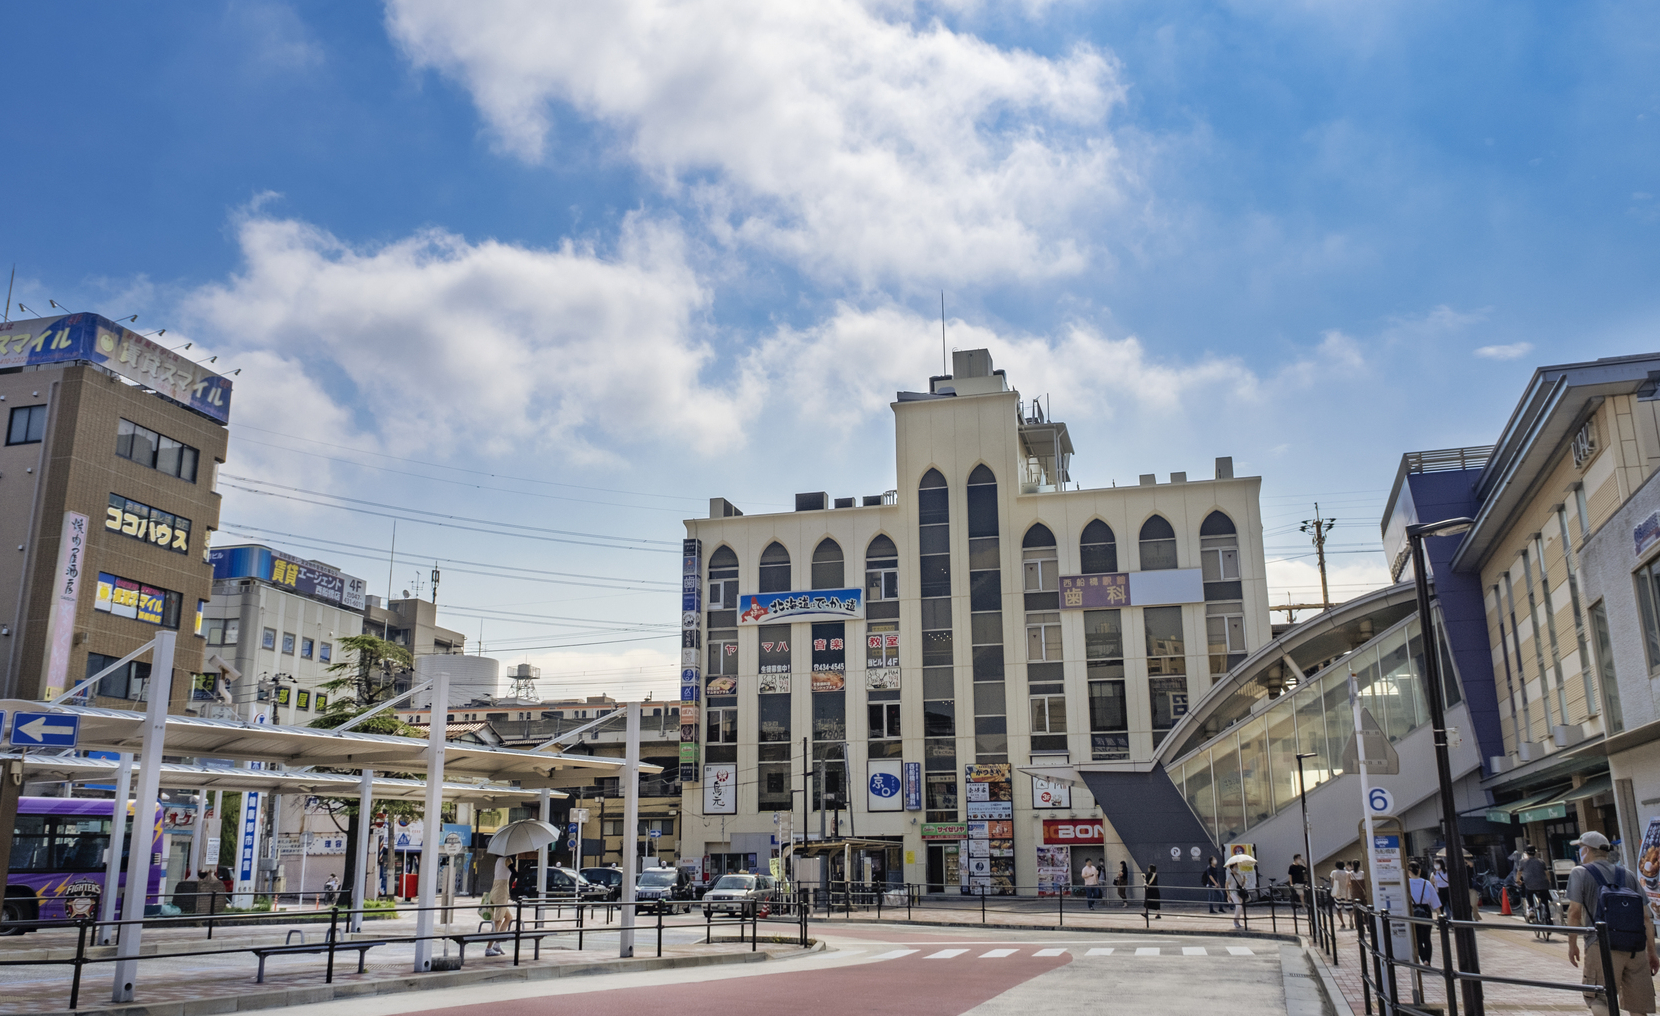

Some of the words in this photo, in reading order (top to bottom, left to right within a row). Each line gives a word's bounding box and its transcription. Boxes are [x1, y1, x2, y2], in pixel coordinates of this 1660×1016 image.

[105, 507, 187, 551] ココハウス
[349, 580, 362, 592] 4F
[1064, 585, 1126, 606] 歯科
[813, 638, 844, 651] 音楽
[868, 635, 899, 648] 教室
[887, 658, 898, 666] 4F
[1369, 788, 1388, 811] 6
[66, 883, 101, 895] FIGHTERS
